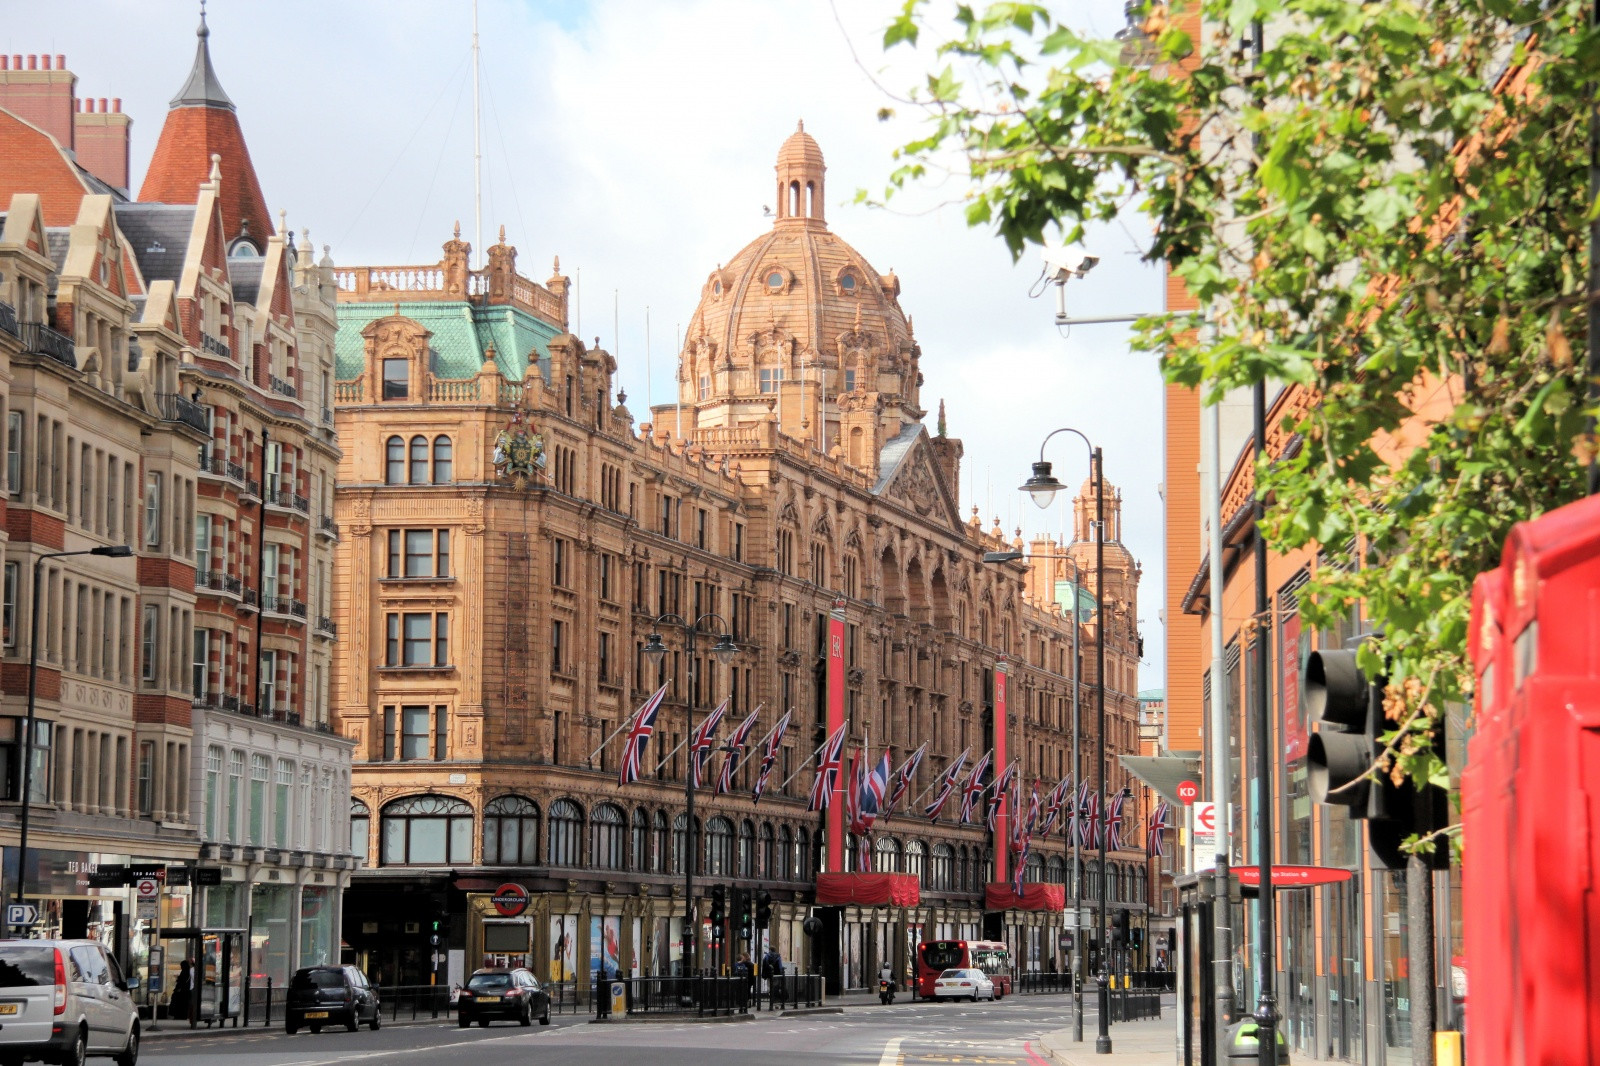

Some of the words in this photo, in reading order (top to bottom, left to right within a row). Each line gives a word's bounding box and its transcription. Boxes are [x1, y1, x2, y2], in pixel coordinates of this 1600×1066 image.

[1180, 788, 1196, 797] KD
[68, 861, 79, 873] TED
[81, 862, 98, 873] BAKER
[11, 907, 23, 922] P
